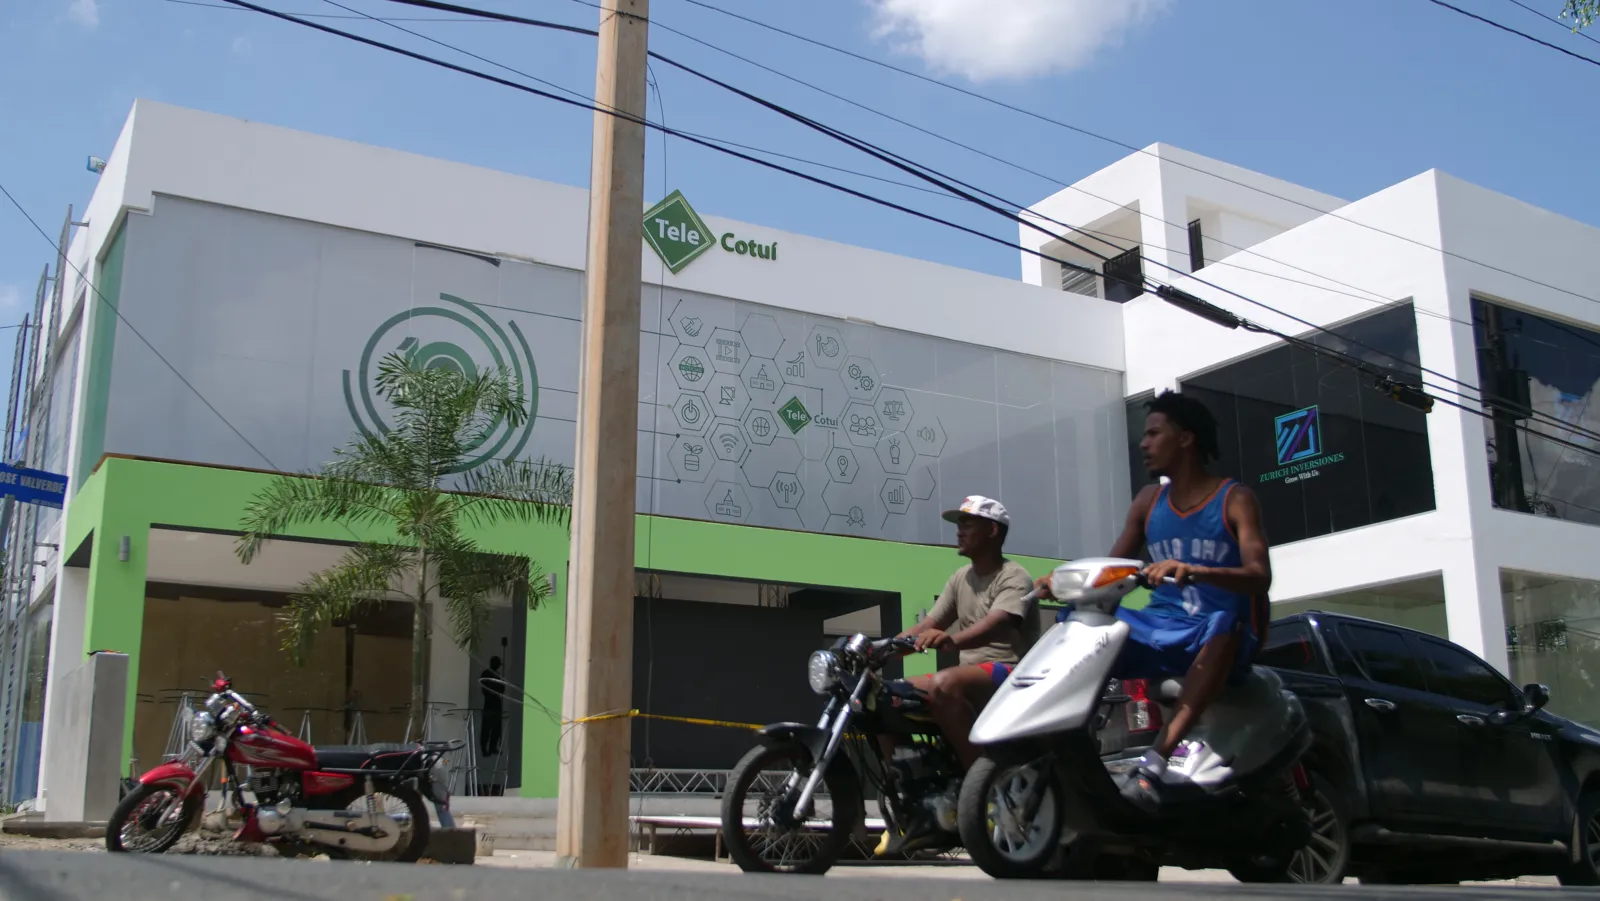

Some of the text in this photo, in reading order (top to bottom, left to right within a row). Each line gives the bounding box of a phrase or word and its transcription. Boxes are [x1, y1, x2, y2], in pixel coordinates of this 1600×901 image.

[655, 218, 778, 261] Tele Cotuí
[786, 409, 807, 421] Tele
[1259, 452, 1345, 483] ZURICH INVERSIONES
[1284, 469, 1319, 484] Grow With Us
[20, 474, 65, 494] VALVERDE
